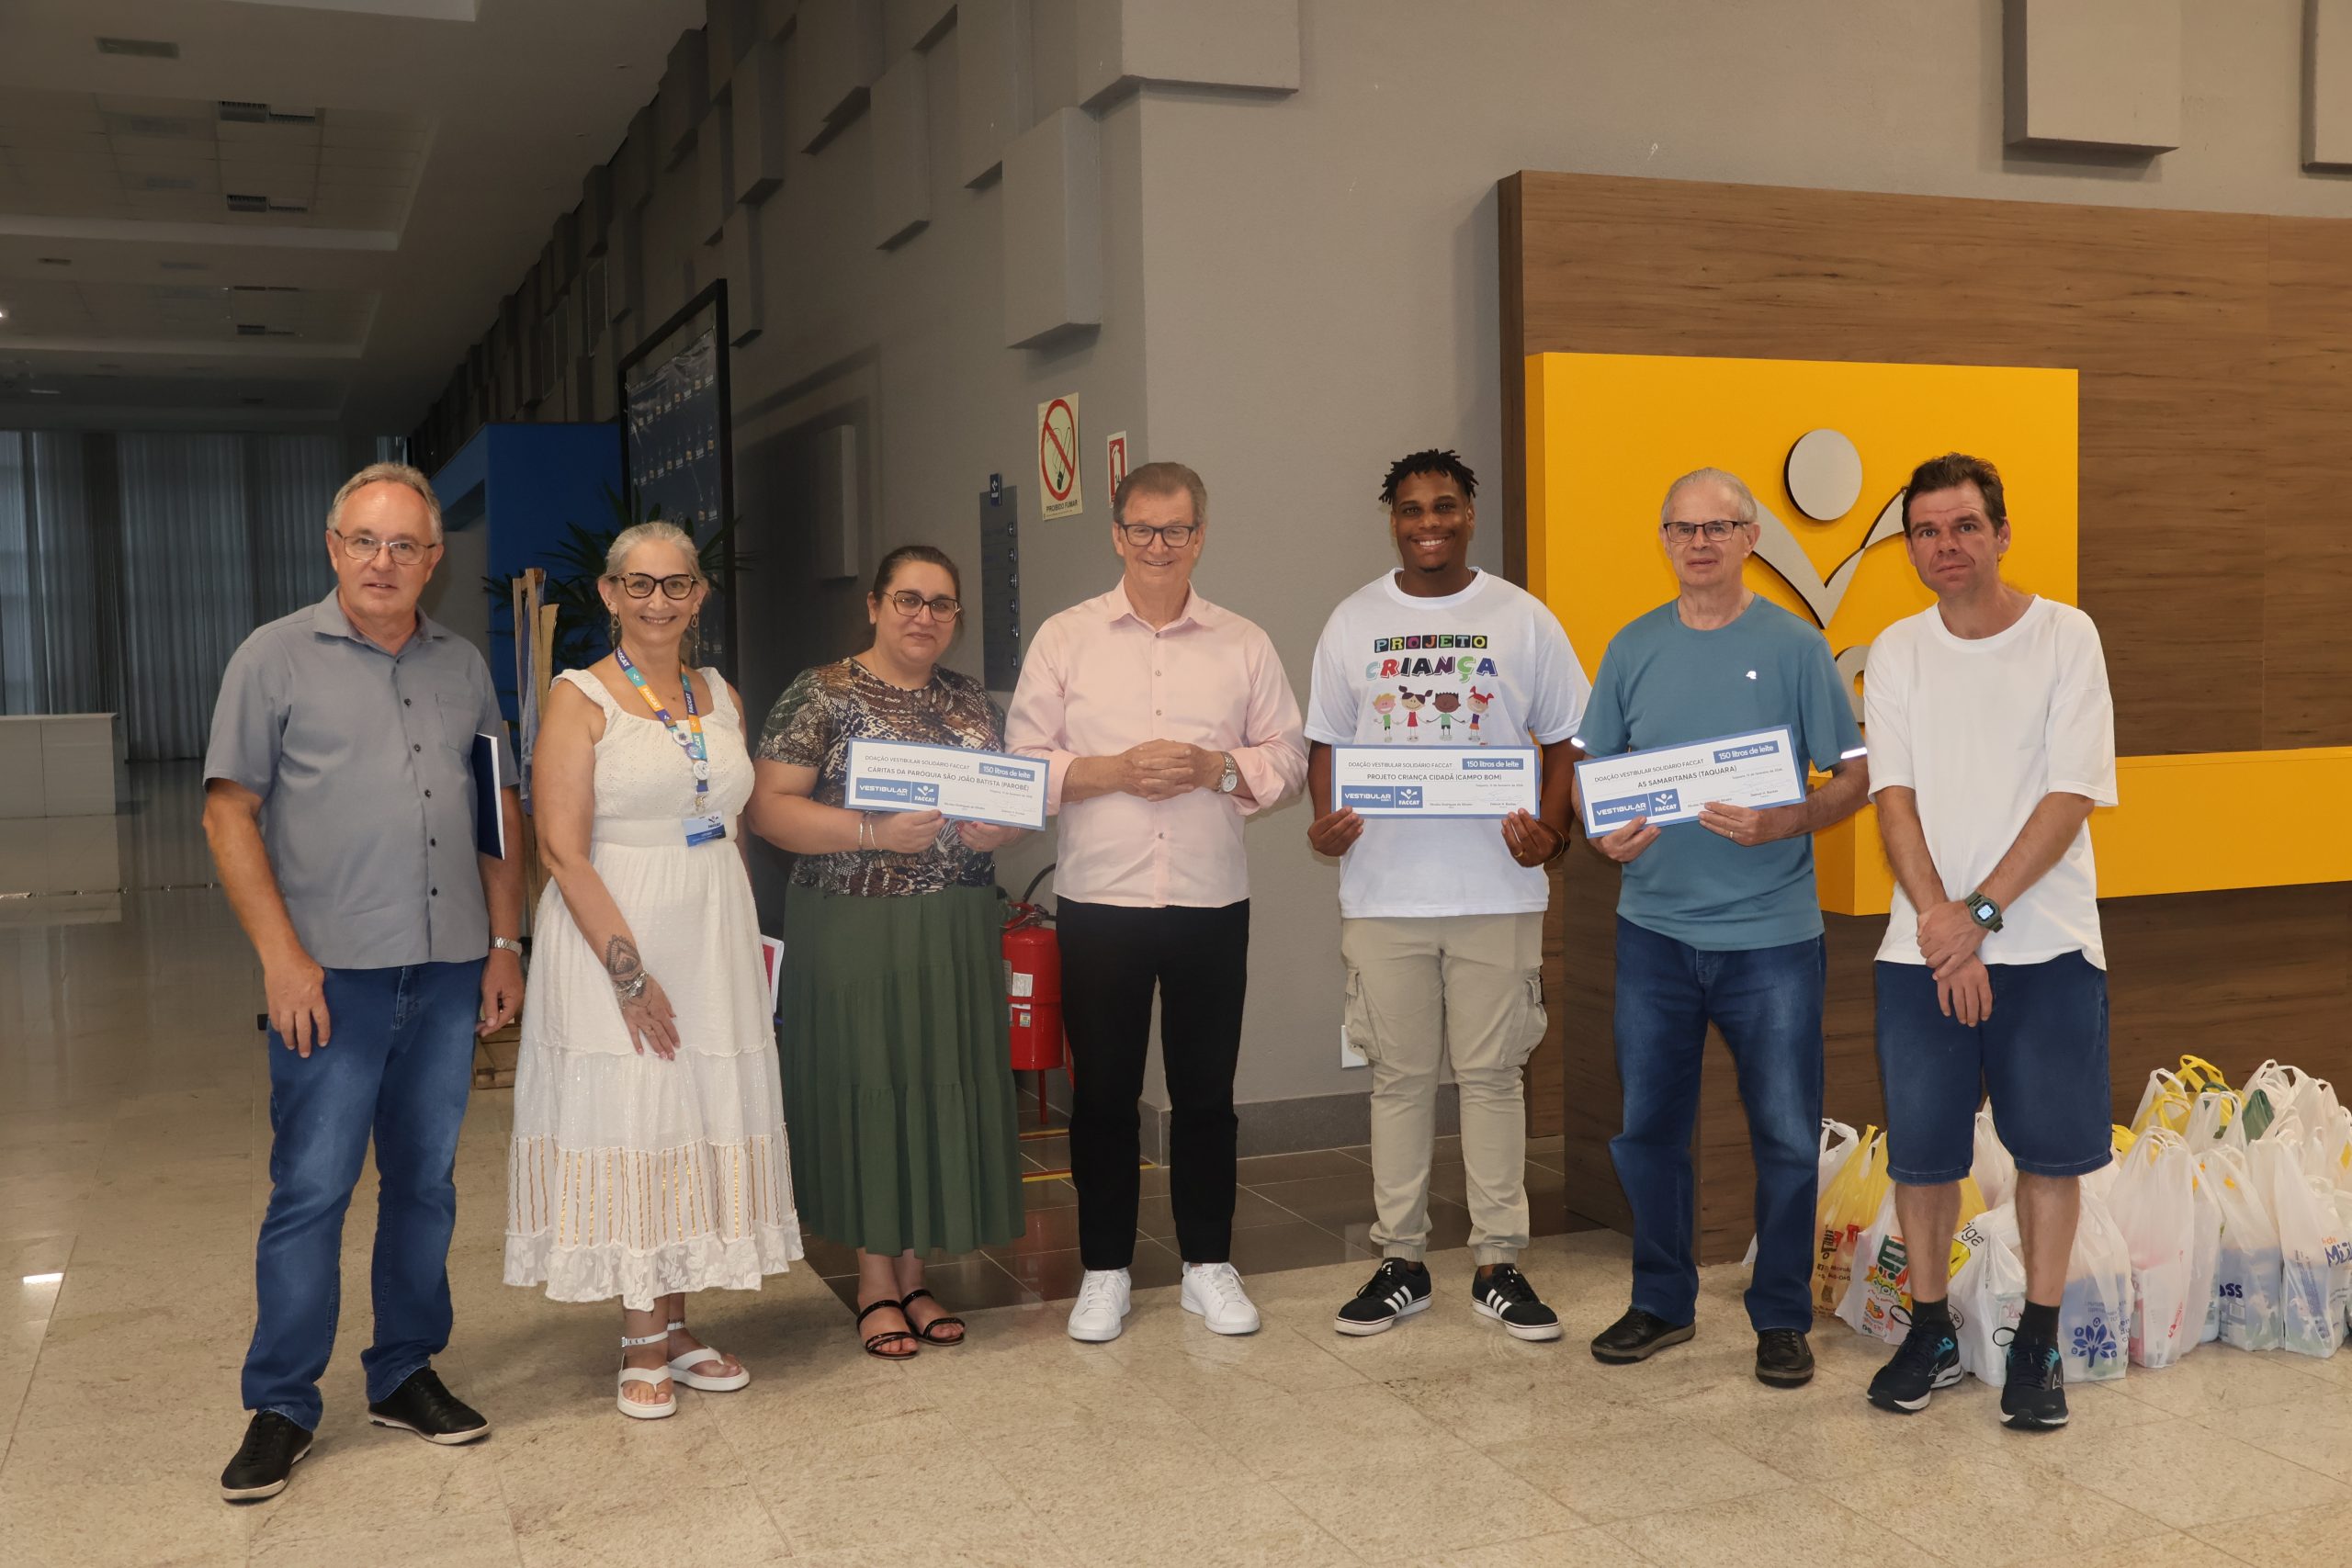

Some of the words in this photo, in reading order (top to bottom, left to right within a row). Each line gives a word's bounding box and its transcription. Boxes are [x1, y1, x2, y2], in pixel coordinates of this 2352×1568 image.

[1374, 635, 1487, 653] PROJETO
[1366, 656, 1498, 683] CRIANÇA
[642, 688, 662, 709] FACCAT
[685, 692, 695, 714] FACCAT
[1731, 750, 1748, 758] litros
[1759, 745, 1774, 753] leite
[995, 767, 1009, 775] litros
[1018, 771, 1031, 779] leite
[1594, 773, 1619, 783] DOAÇÃO
[1619, 768, 1651, 778] VESTIBULAR
[1652, 762, 1682, 772] SOLIDÁRIO
[1682, 758, 1704, 767] FACCAT
[1648, 772, 1698, 786] SAMARITANAS
[1698, 765, 1737, 778] (TAQUARA)
[958, 774, 975, 783] JOÃO
[976, 779, 1000, 787] BATISTA
[859, 785, 908, 794] VESTIBULAR
[1596, 802, 1647, 816] VESTIBULAR
[1654, 804, 1677, 812] FACCAT
